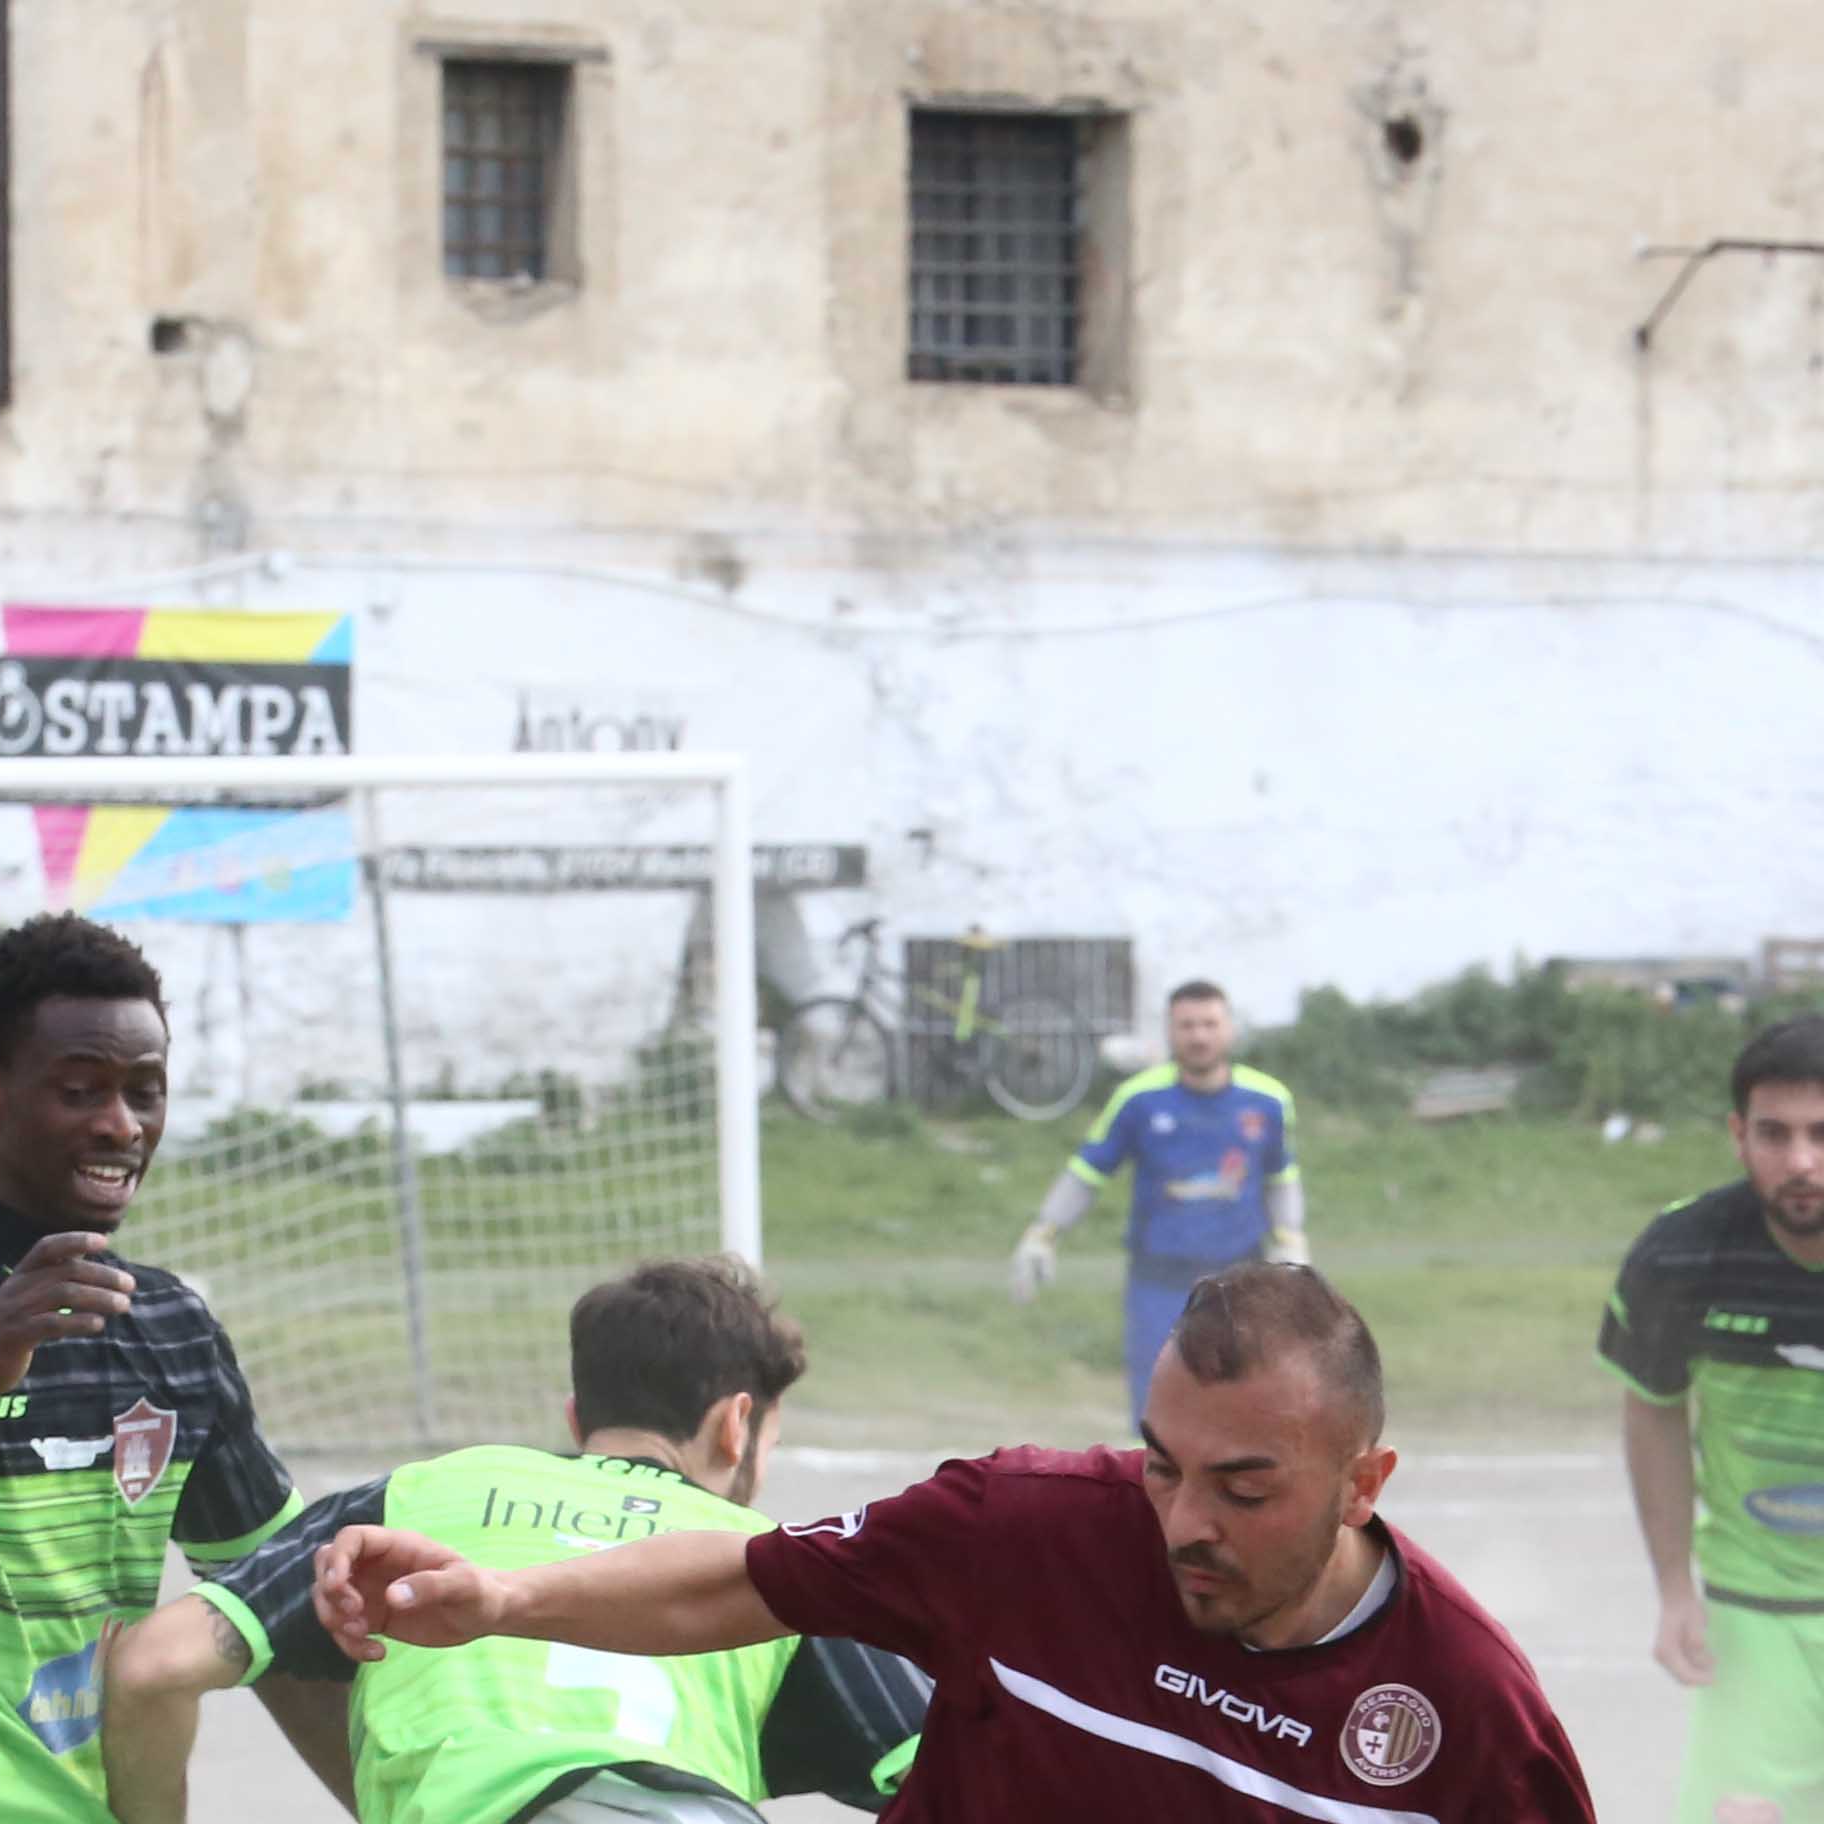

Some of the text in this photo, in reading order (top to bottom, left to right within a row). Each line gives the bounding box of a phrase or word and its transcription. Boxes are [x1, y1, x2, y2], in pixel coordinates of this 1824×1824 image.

[482, 1487, 678, 1541] Inten
[1154, 1662, 1313, 1747] GIVOVA
[1358, 1692, 1432, 1727] REAL AGRO
[1355, 1758, 1409, 1778] AVERSA
